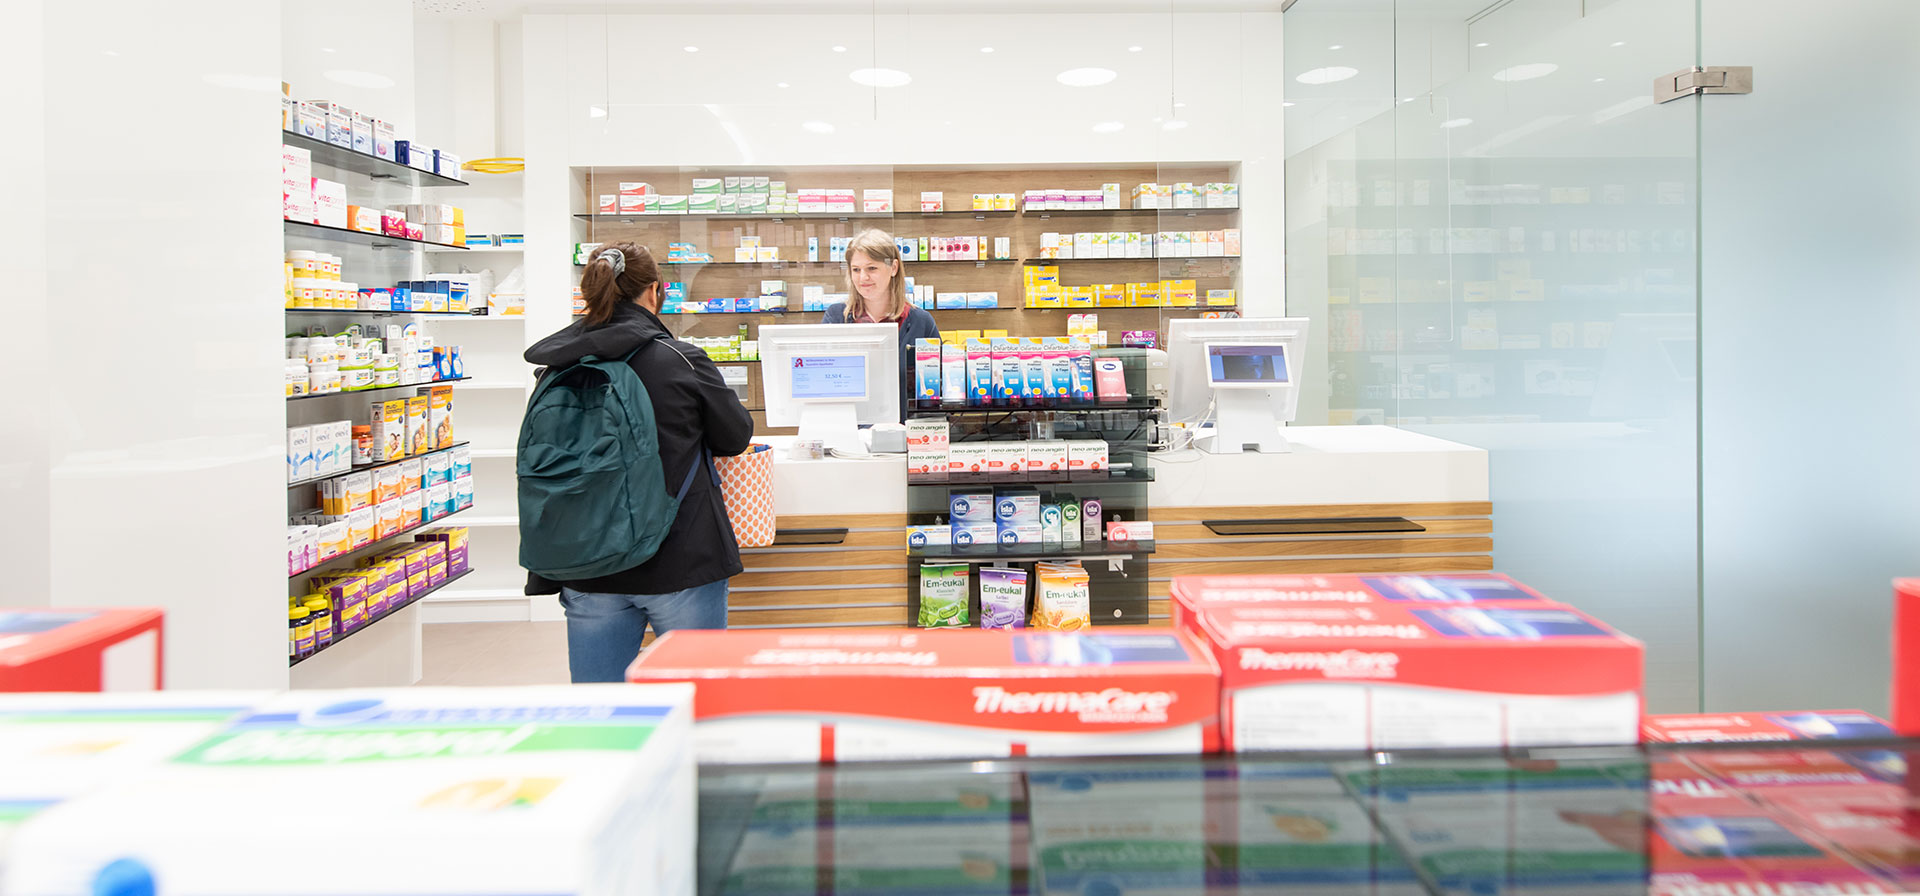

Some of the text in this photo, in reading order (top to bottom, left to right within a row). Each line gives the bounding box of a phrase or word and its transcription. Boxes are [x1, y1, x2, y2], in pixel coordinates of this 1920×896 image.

[926, 578, 965, 588] Em-eukal
[982, 584, 1022, 595] Em-eukal
[972, 686, 1171, 714] ThermaCare
